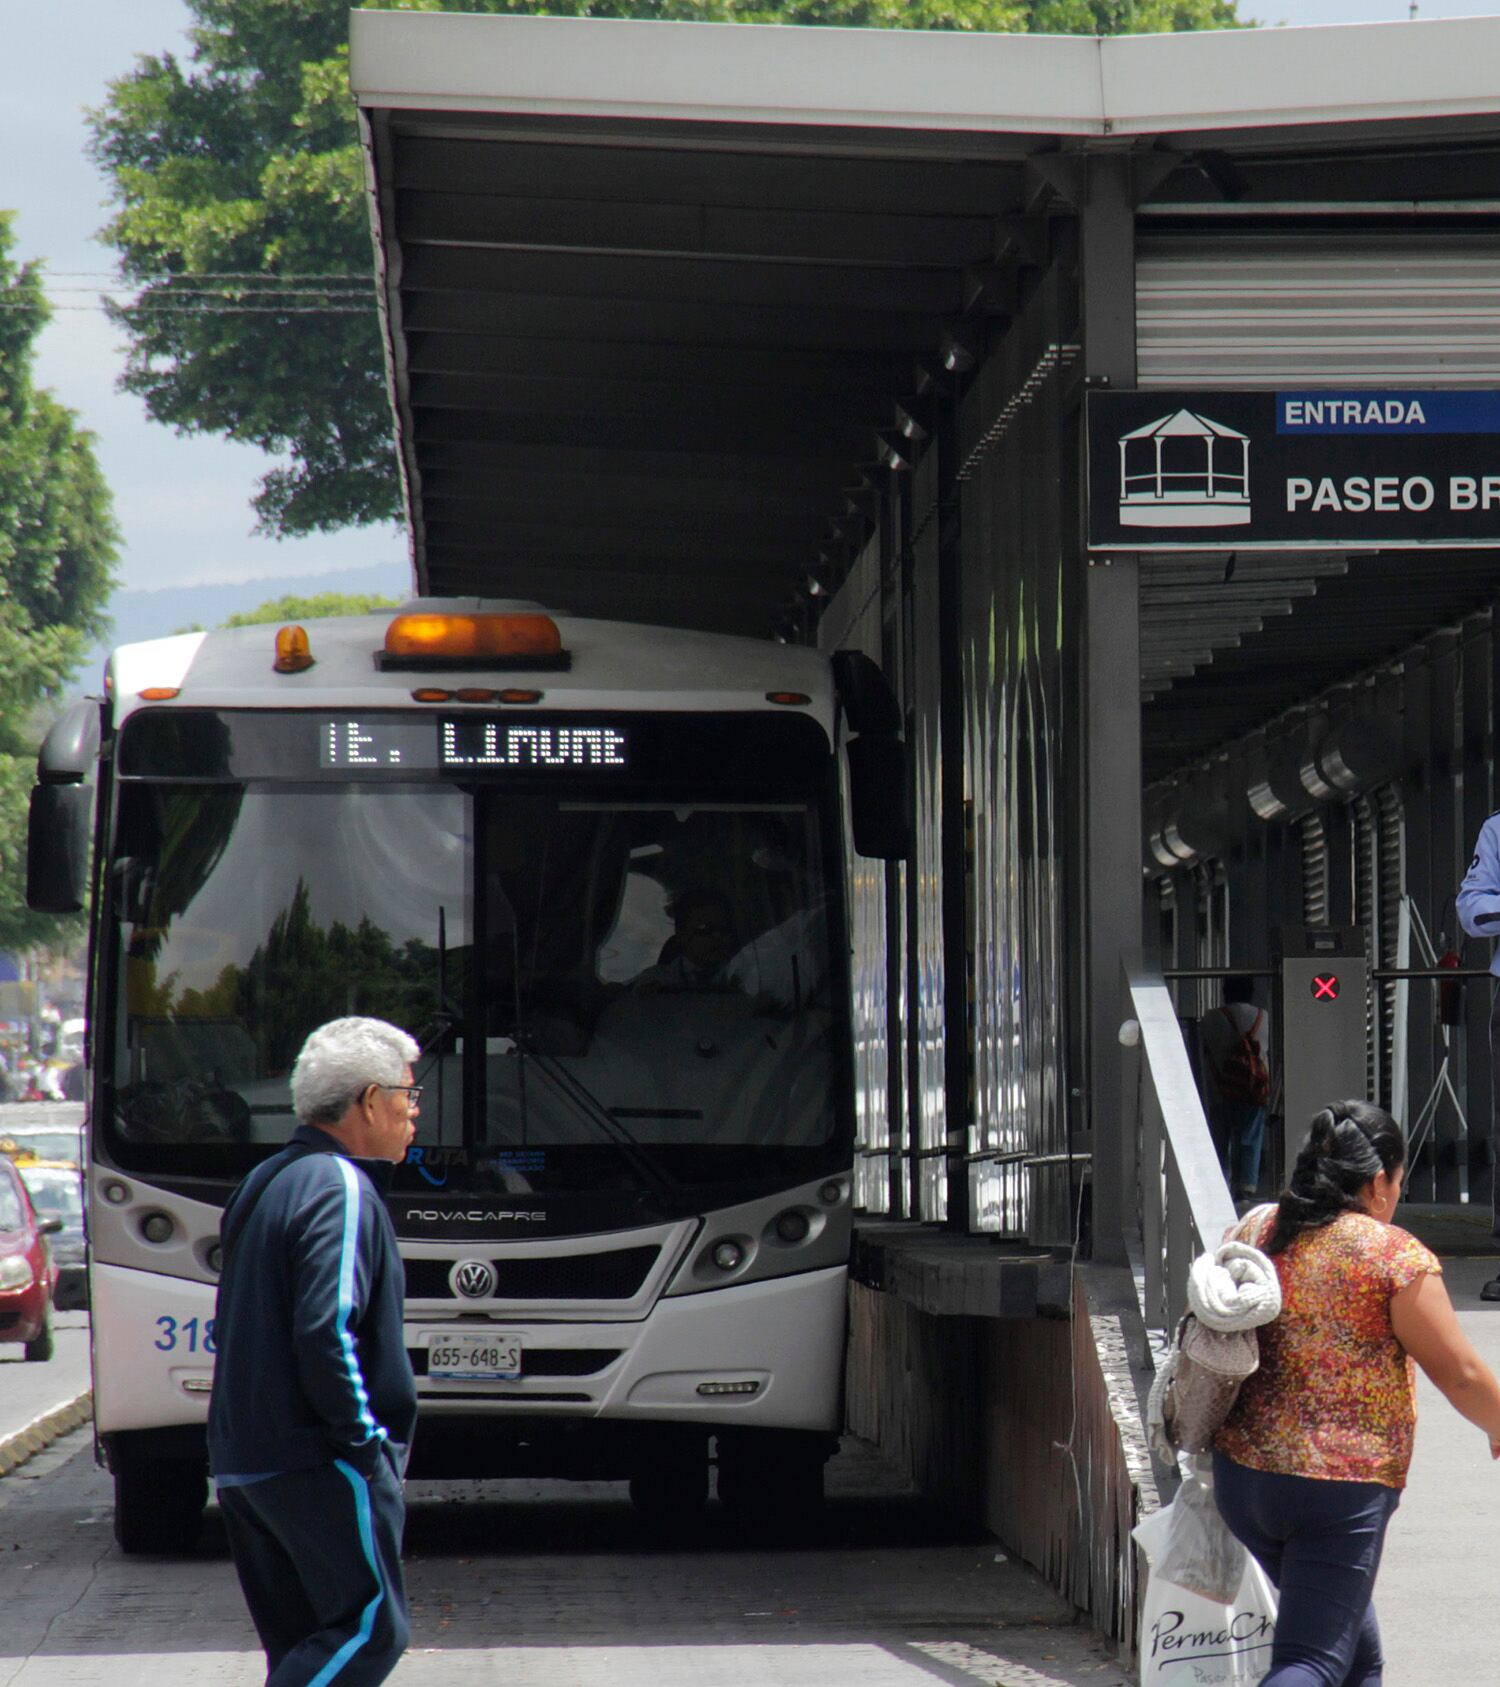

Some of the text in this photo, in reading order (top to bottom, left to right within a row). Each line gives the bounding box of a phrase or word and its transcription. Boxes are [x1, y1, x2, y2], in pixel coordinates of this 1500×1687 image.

[1285, 400, 1426, 425] ENTRADA
[1286, 476, 1434, 512] PASEO
[406, 1209, 547, 1221] NOVACAPRE
[432, 1347, 518, 1368] 655-648-S
